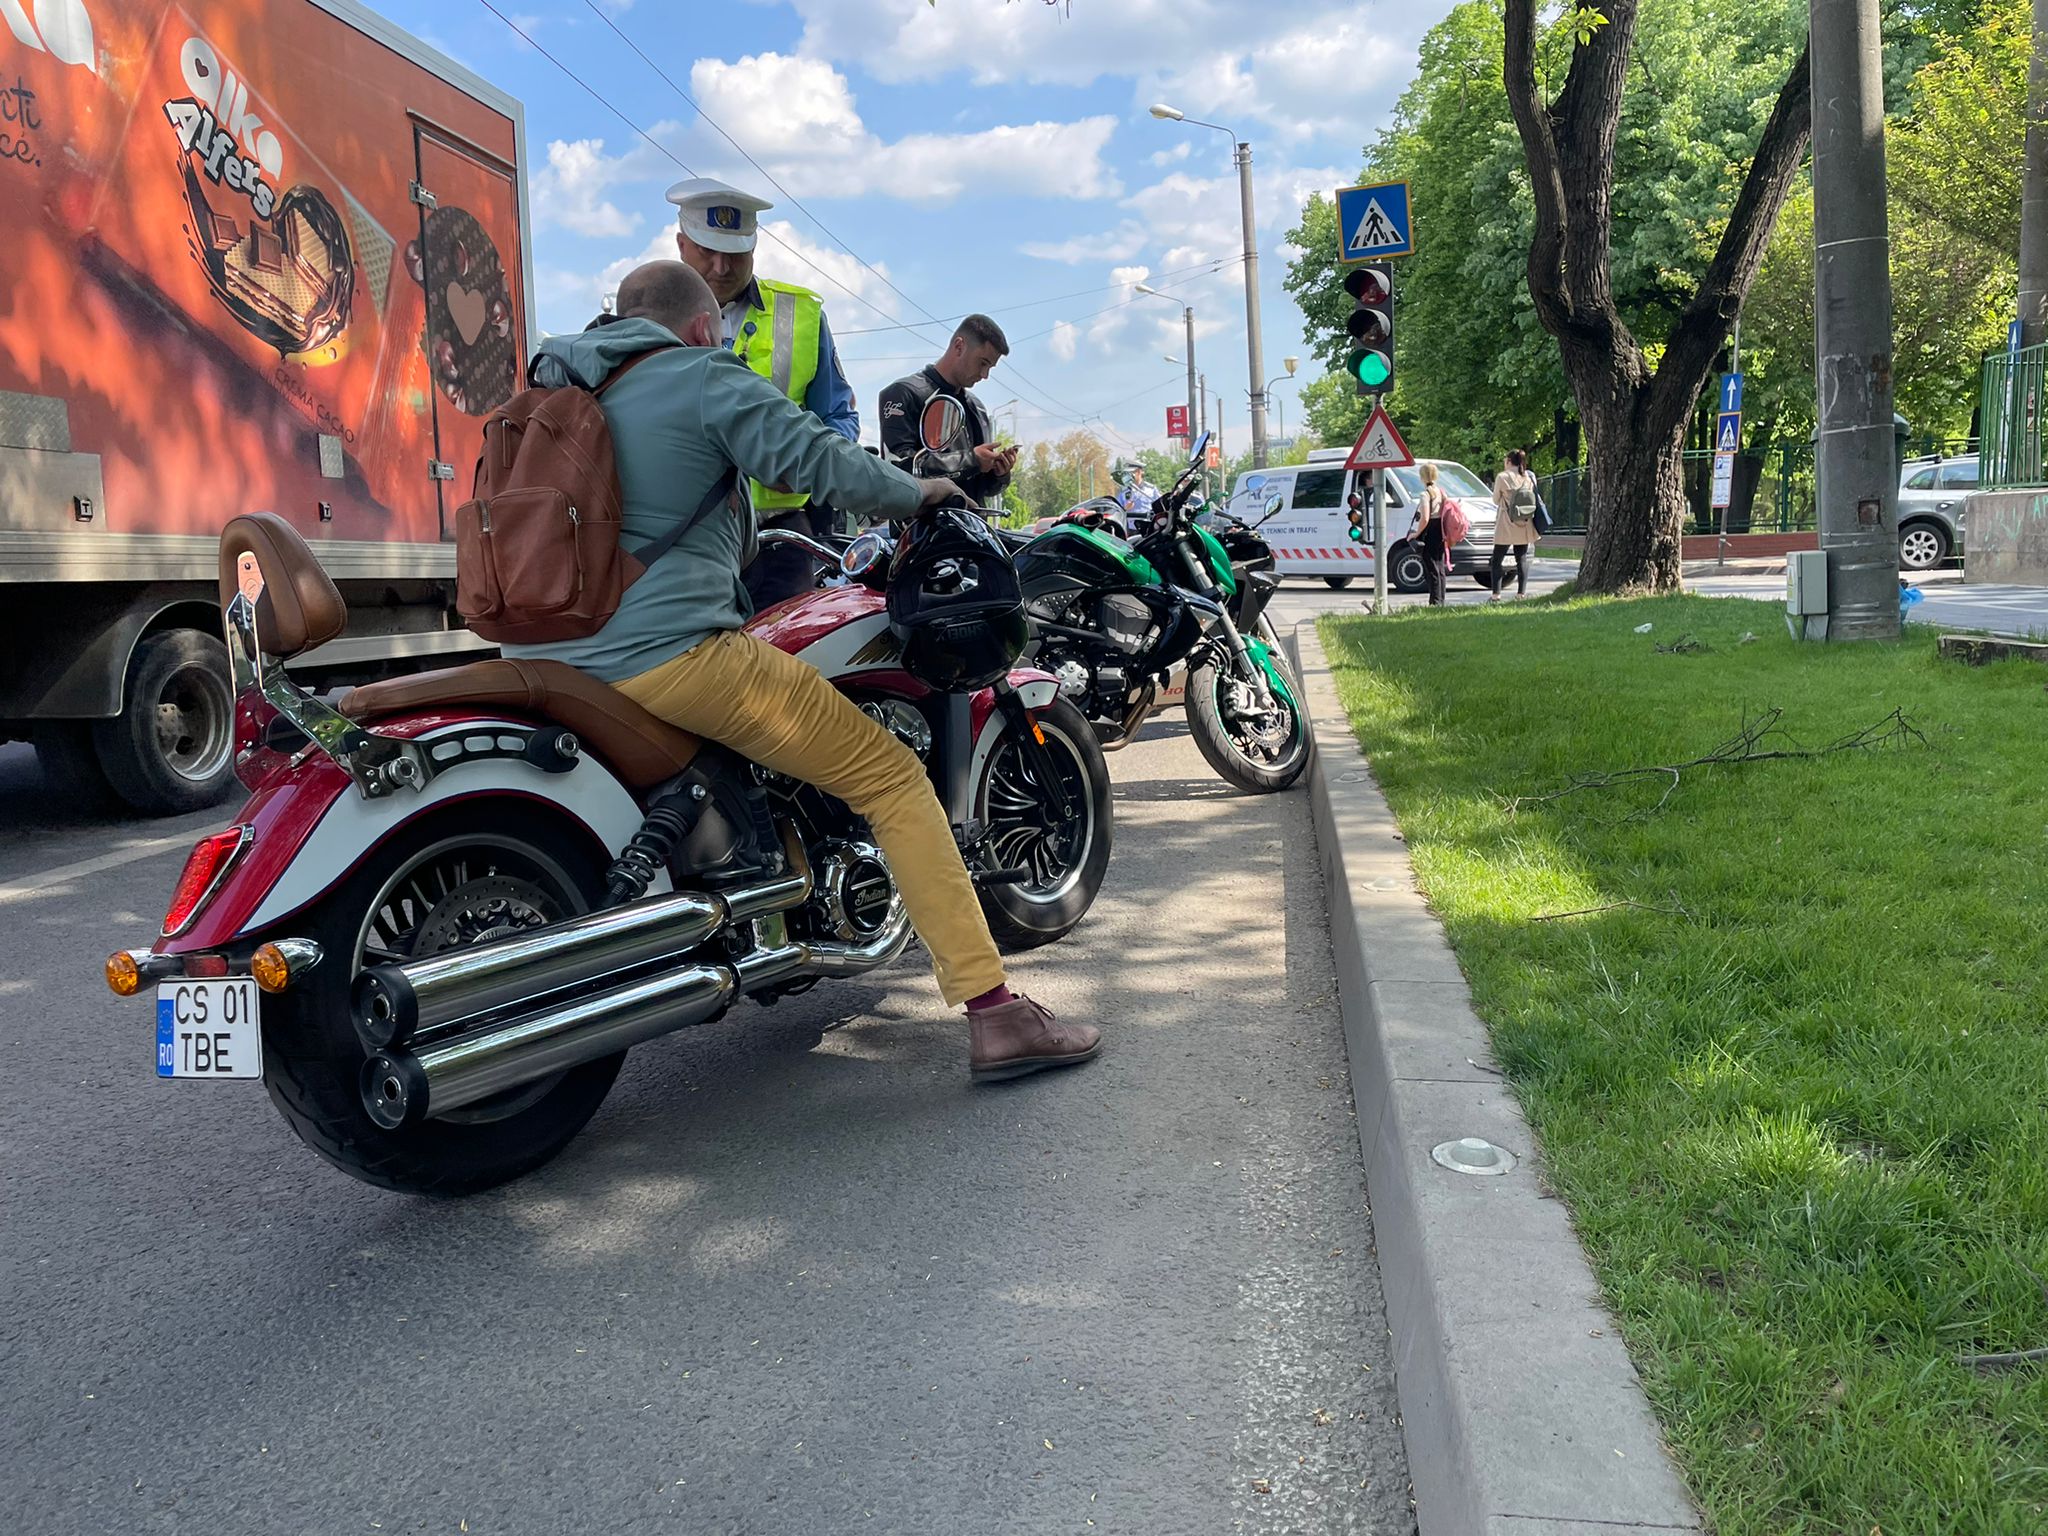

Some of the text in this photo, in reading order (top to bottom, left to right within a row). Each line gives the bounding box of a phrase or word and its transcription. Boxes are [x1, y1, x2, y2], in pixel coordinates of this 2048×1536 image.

[164, 99, 274, 219] Alfers
[316, 404, 354, 444] CACAO
[1163, 686, 1185, 696] HO
[175, 984, 249, 1025] CS 01
[159, 1043, 174, 1067] RO
[180, 1032, 234, 1073] TBE
